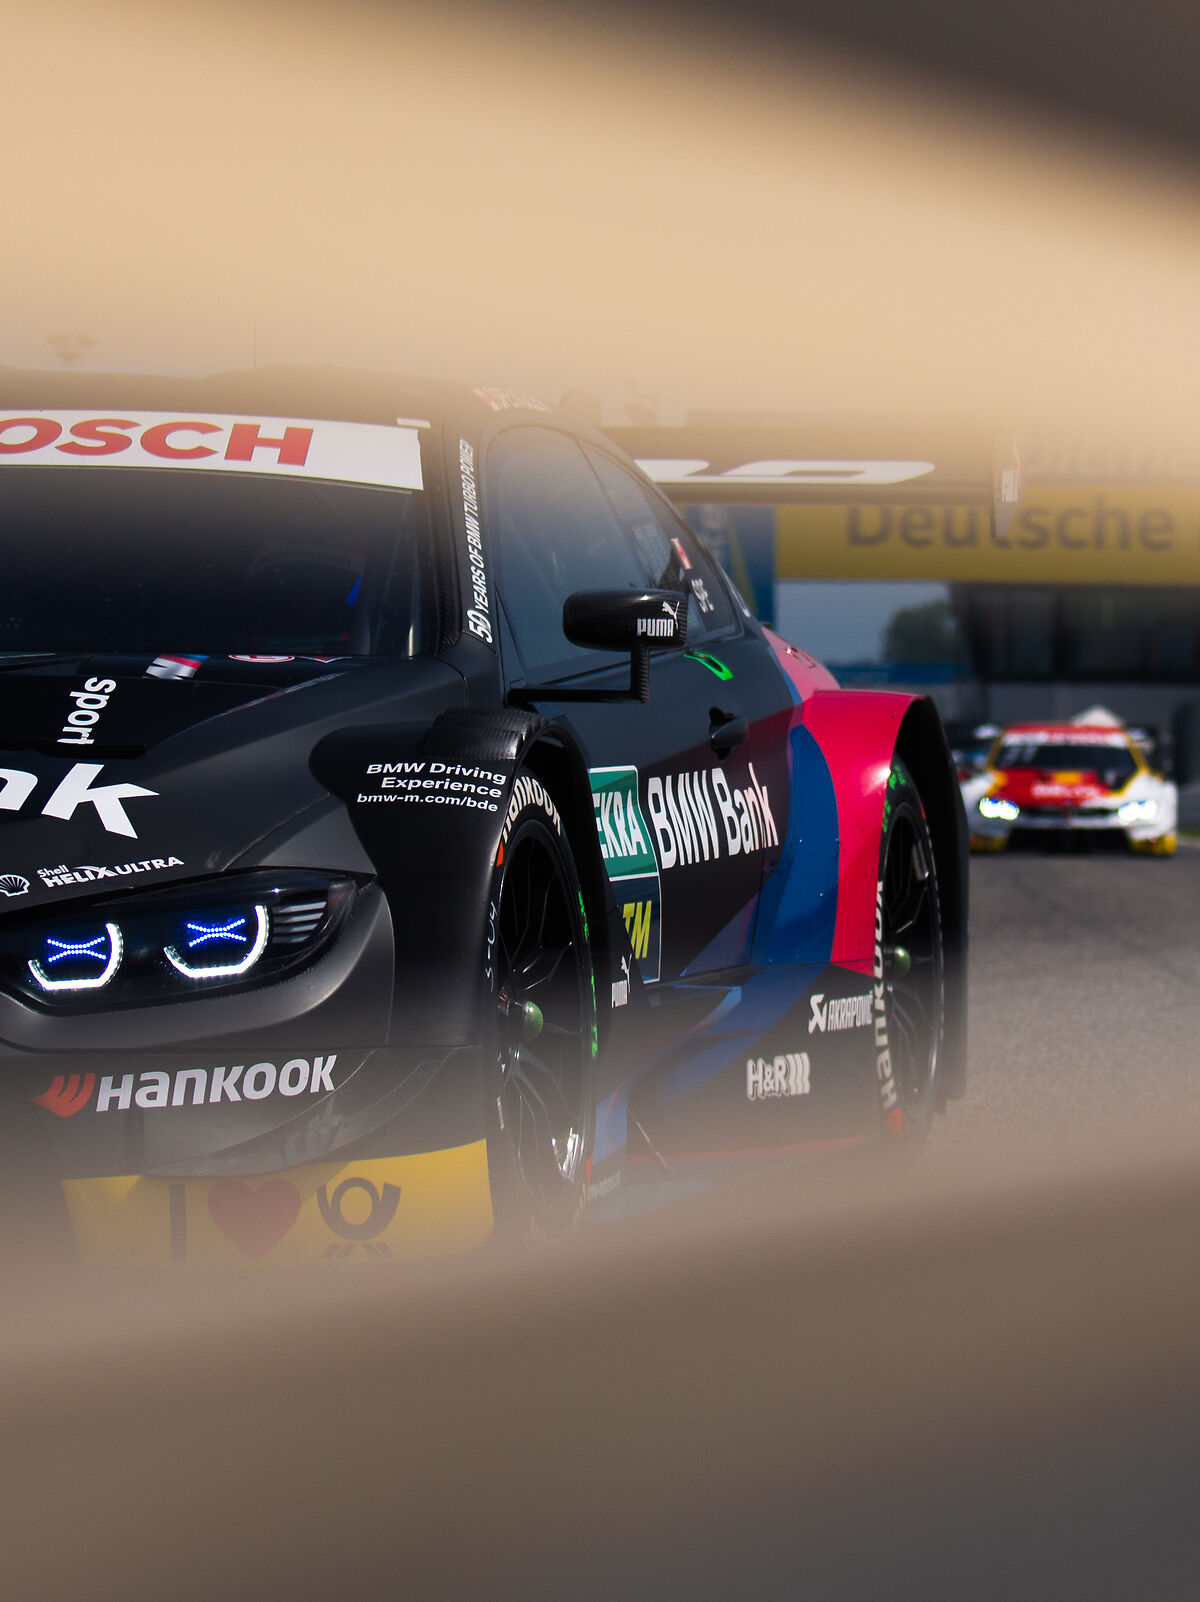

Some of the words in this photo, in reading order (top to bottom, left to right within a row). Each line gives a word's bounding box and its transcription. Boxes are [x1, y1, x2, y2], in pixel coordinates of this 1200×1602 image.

[459, 438, 475, 479] POWER
[462, 477, 479, 518] TURBO
[465, 514, 482, 551] BMW
[469, 544, 485, 569] OF
[471, 566, 490, 614] YEARS
[467, 608, 493, 644] 50
[637, 618, 674, 637] PUMA
[57, 676, 117, 745] sport
[366, 762, 426, 775] BMW
[429, 762, 507, 786] Driving
[381, 776, 502, 799] Experience
[357, 792, 499, 812] bmw-m.com/bde
[648, 770, 720, 870] BMW
[712, 762, 780, 857] Bank
[592, 789, 648, 859] EKRA
[37, 864, 69, 878] Shell
[43, 866, 118, 888] HELIX
[114, 856, 185, 876] ULTRA
[747, 1053, 789, 1100] H&R
